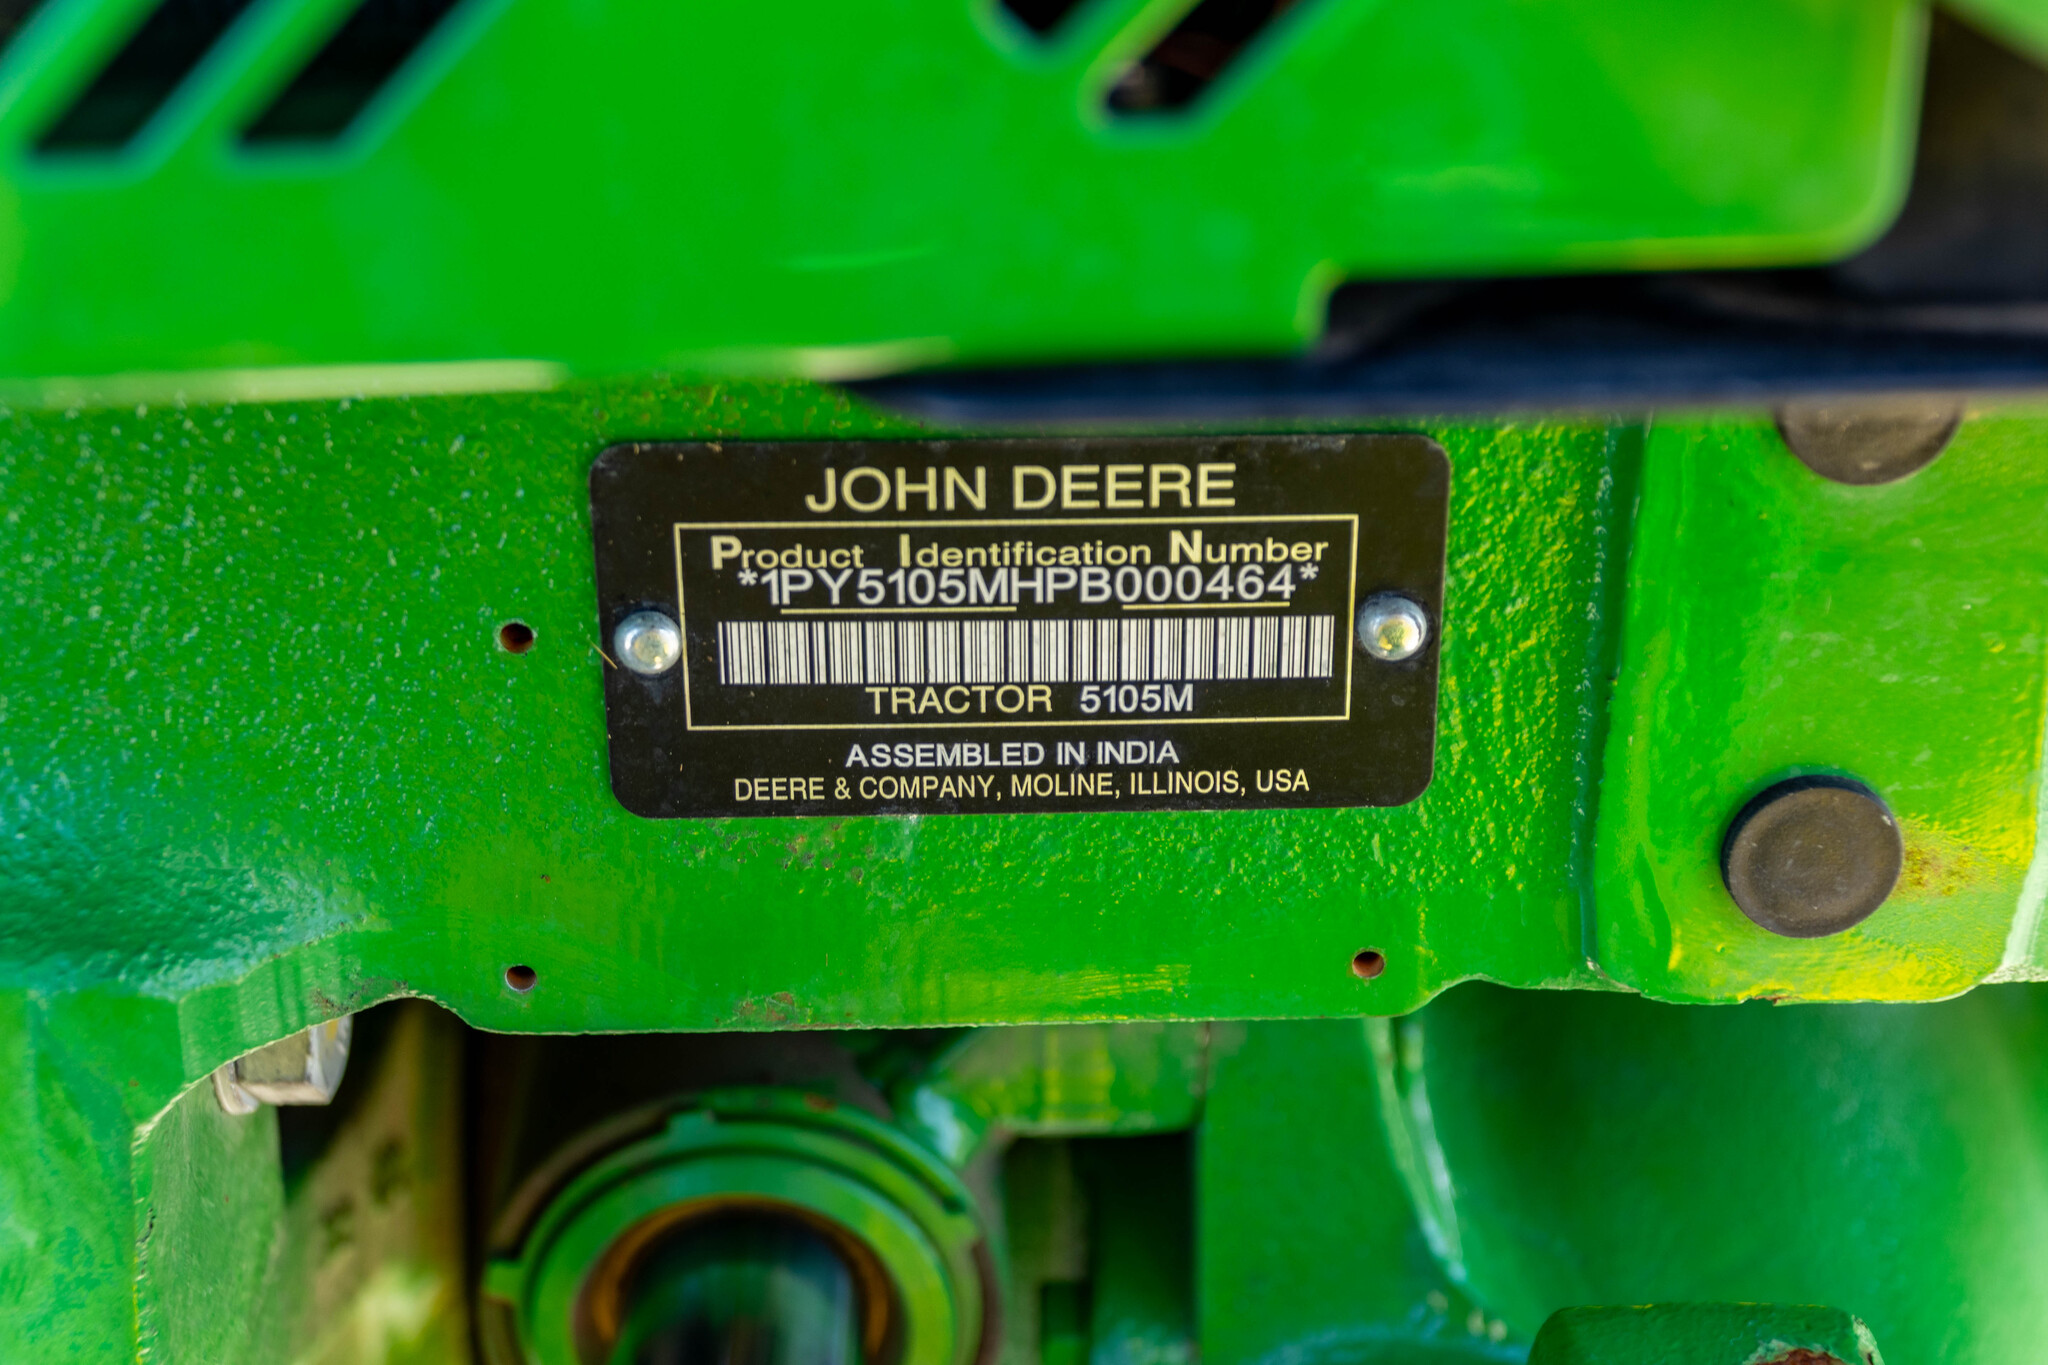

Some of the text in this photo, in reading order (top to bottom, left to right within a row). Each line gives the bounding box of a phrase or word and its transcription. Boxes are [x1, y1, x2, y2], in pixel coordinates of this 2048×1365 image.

[805, 462, 1236, 513] JOHN DEERE
[710, 529, 1329, 570] Product Identification Number
[865, 683, 1194, 715] TRACTOR 5105M
[845, 740, 1180, 768] ASSEMBLED IN INDIA
[734, 768, 1310, 801] DEERE & COMPANY, MOLINE, ILLINOIS, USA
